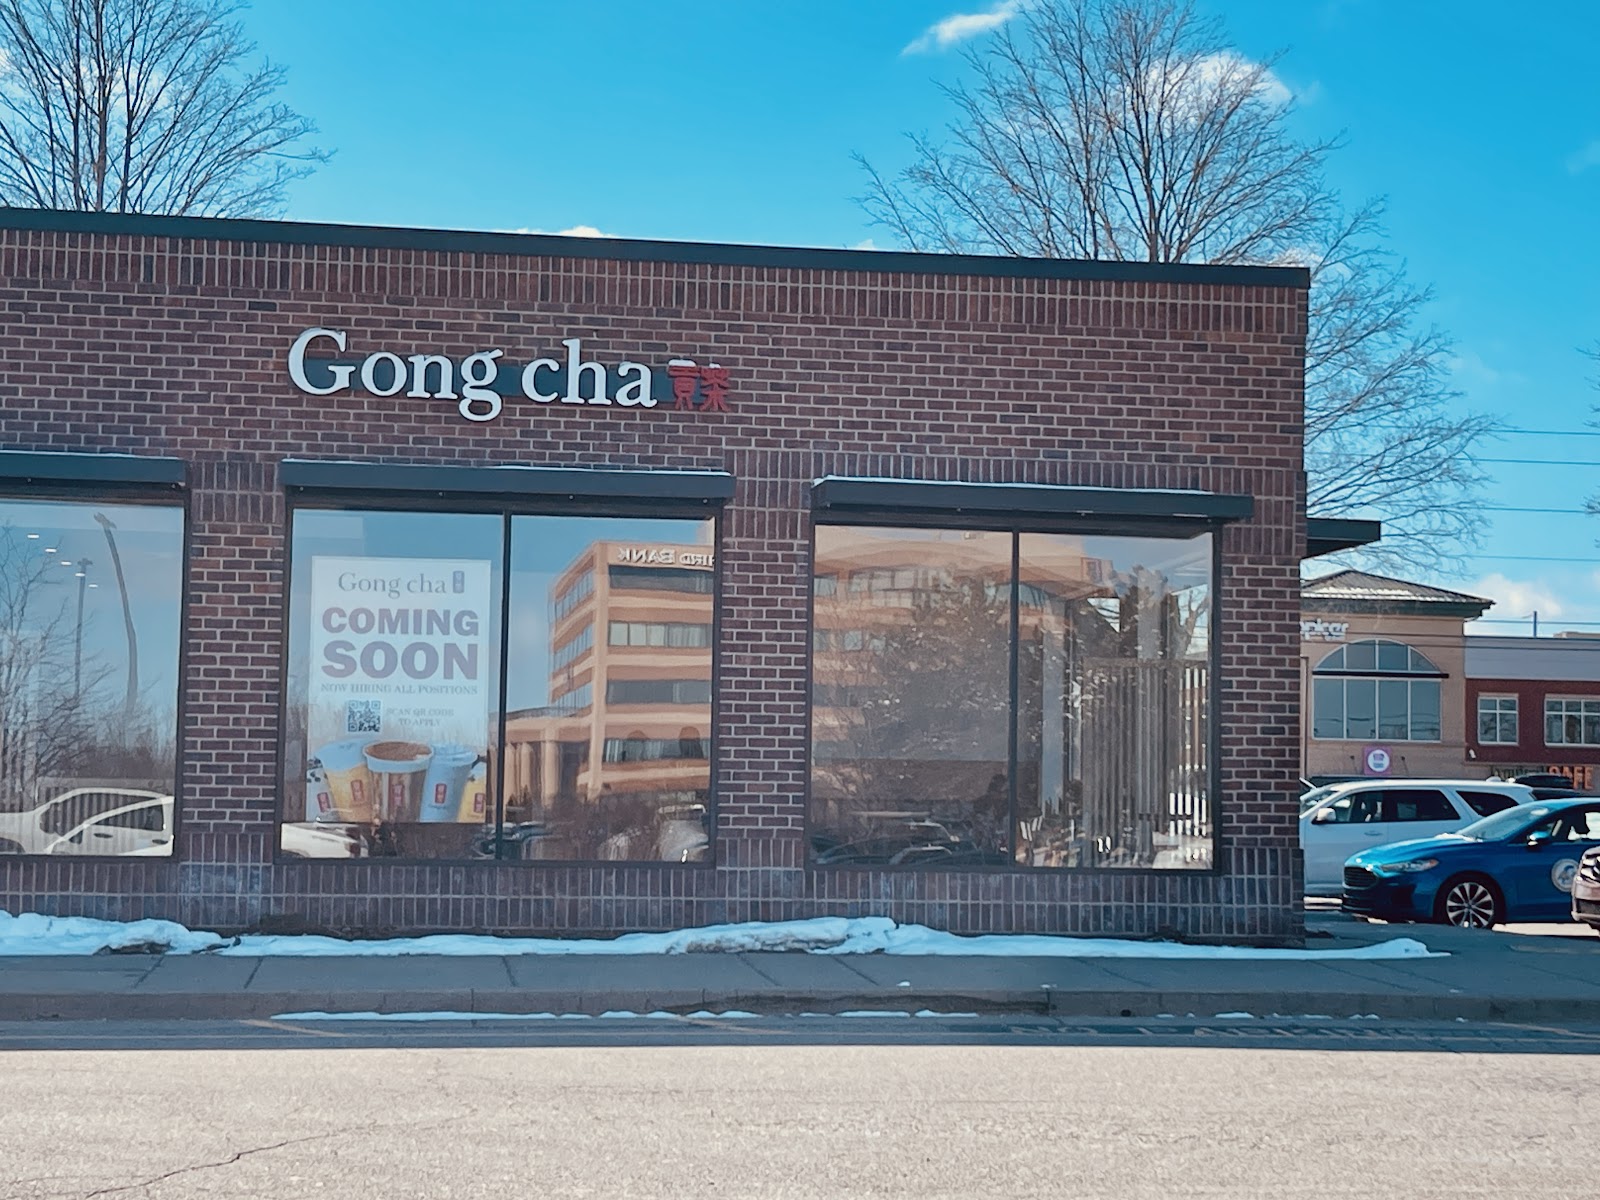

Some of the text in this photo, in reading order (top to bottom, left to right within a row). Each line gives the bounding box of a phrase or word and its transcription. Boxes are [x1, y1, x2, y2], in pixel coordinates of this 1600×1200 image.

[287, 326, 657, 422] Gong cha
[338, 572, 401, 598] Gong
[406, 573, 448, 595] cha
[322, 607, 479, 636] COMING
[321, 640, 478, 680] SOON
[320, 683, 479, 695] NOW HIRING ALL POSITIONS
